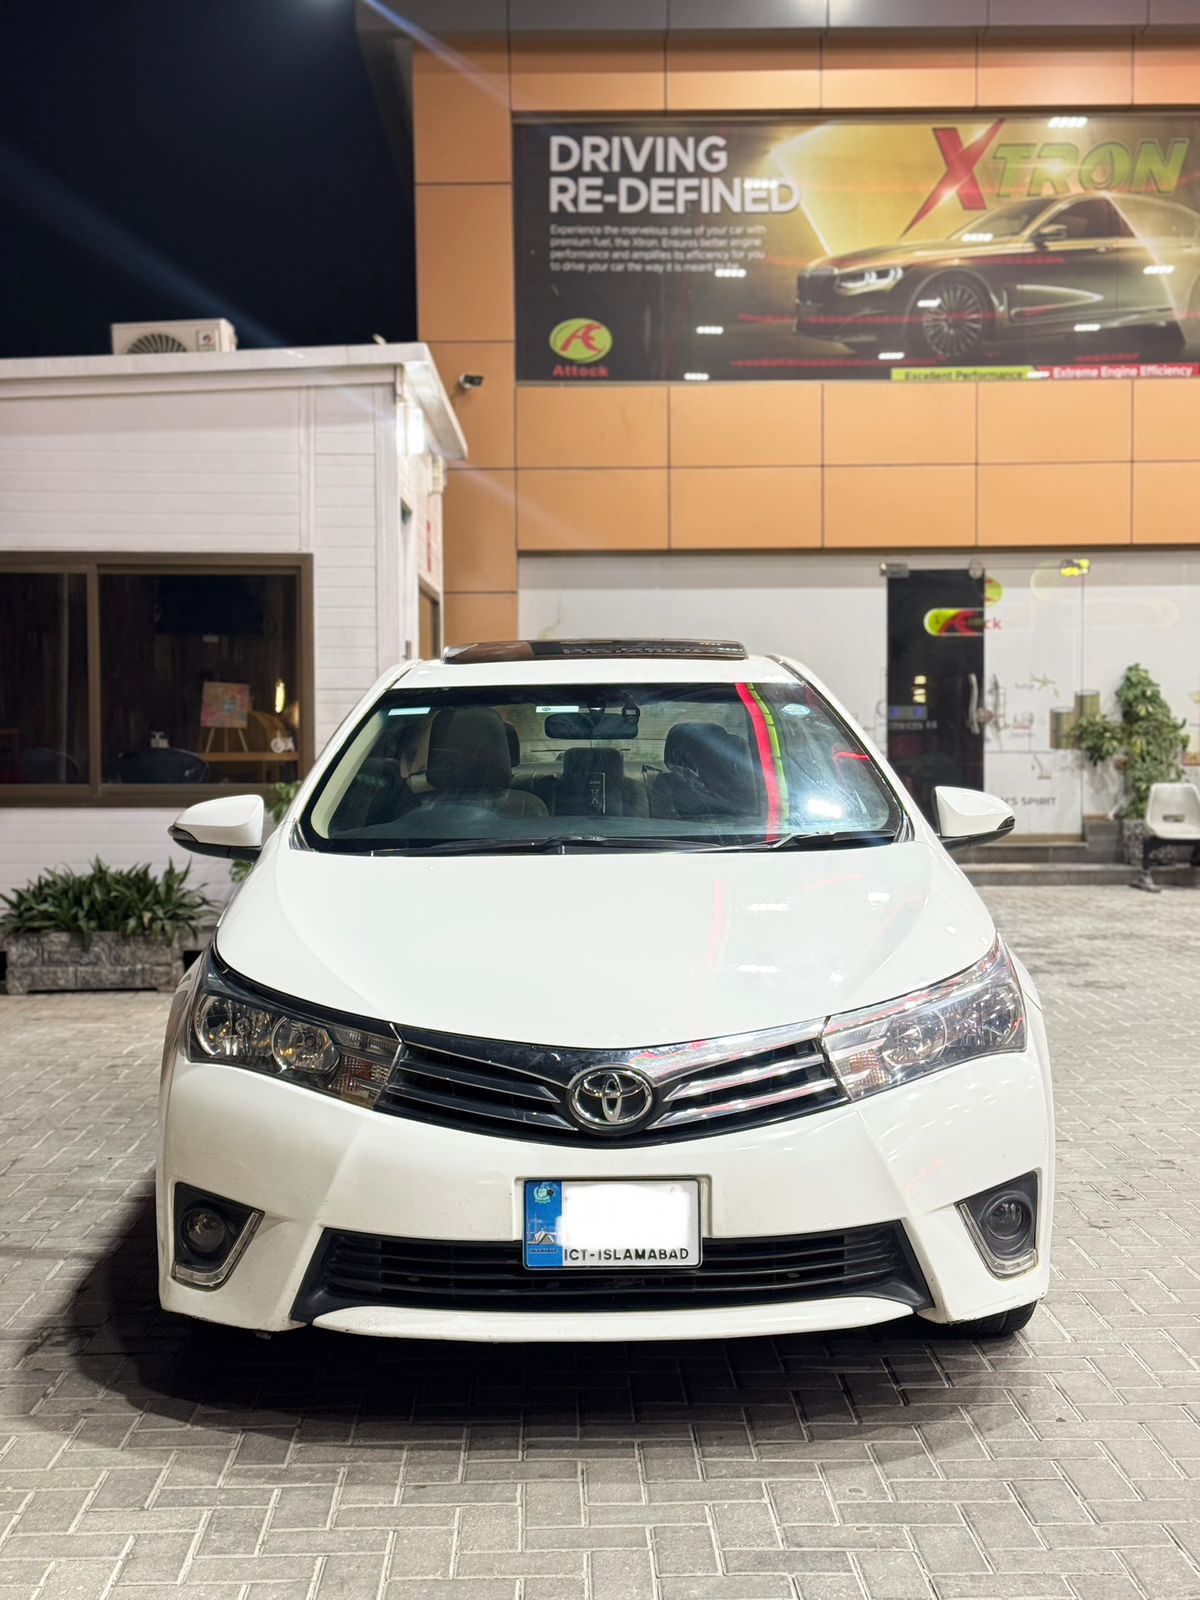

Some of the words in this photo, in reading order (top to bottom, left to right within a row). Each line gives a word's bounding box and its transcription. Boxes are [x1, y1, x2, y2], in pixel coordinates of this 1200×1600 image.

[550, 135, 728, 173] DRIVING
[901, 117, 1189, 240] XTRON
[550, 177, 801, 213] RE-DEFINED
[549, 224, 602, 237] Experience
[604, 224, 619, 237] the
[670, 224, 692, 237] drive
[694, 224, 704, 237] of
[706, 224, 728, 237] your
[728, 224, 744, 237] car
[746, 224, 766, 237] with
[549, 237, 591, 249] premium
[614, 237, 631, 249] the
[549, 249, 609, 261] performance
[612, 249, 630, 261] and
[549, 261, 560, 273] to
[562, 261, 585, 273] drive
[587, 261, 609, 273] your
[610, 261, 624, 273] car
[627, 261, 642, 273] the
[553, 364, 609, 378] Attock
[904, 370, 951, 381] Excellent
[955, 369, 1024, 381] Performance
[1053, 366, 1098, 378] Extreme
[1101, 366, 1138, 378] Engine
[1140, 364, 1192, 377] Efficiency
[564, 1247, 689, 1261] ICT-ISLAMABAD
